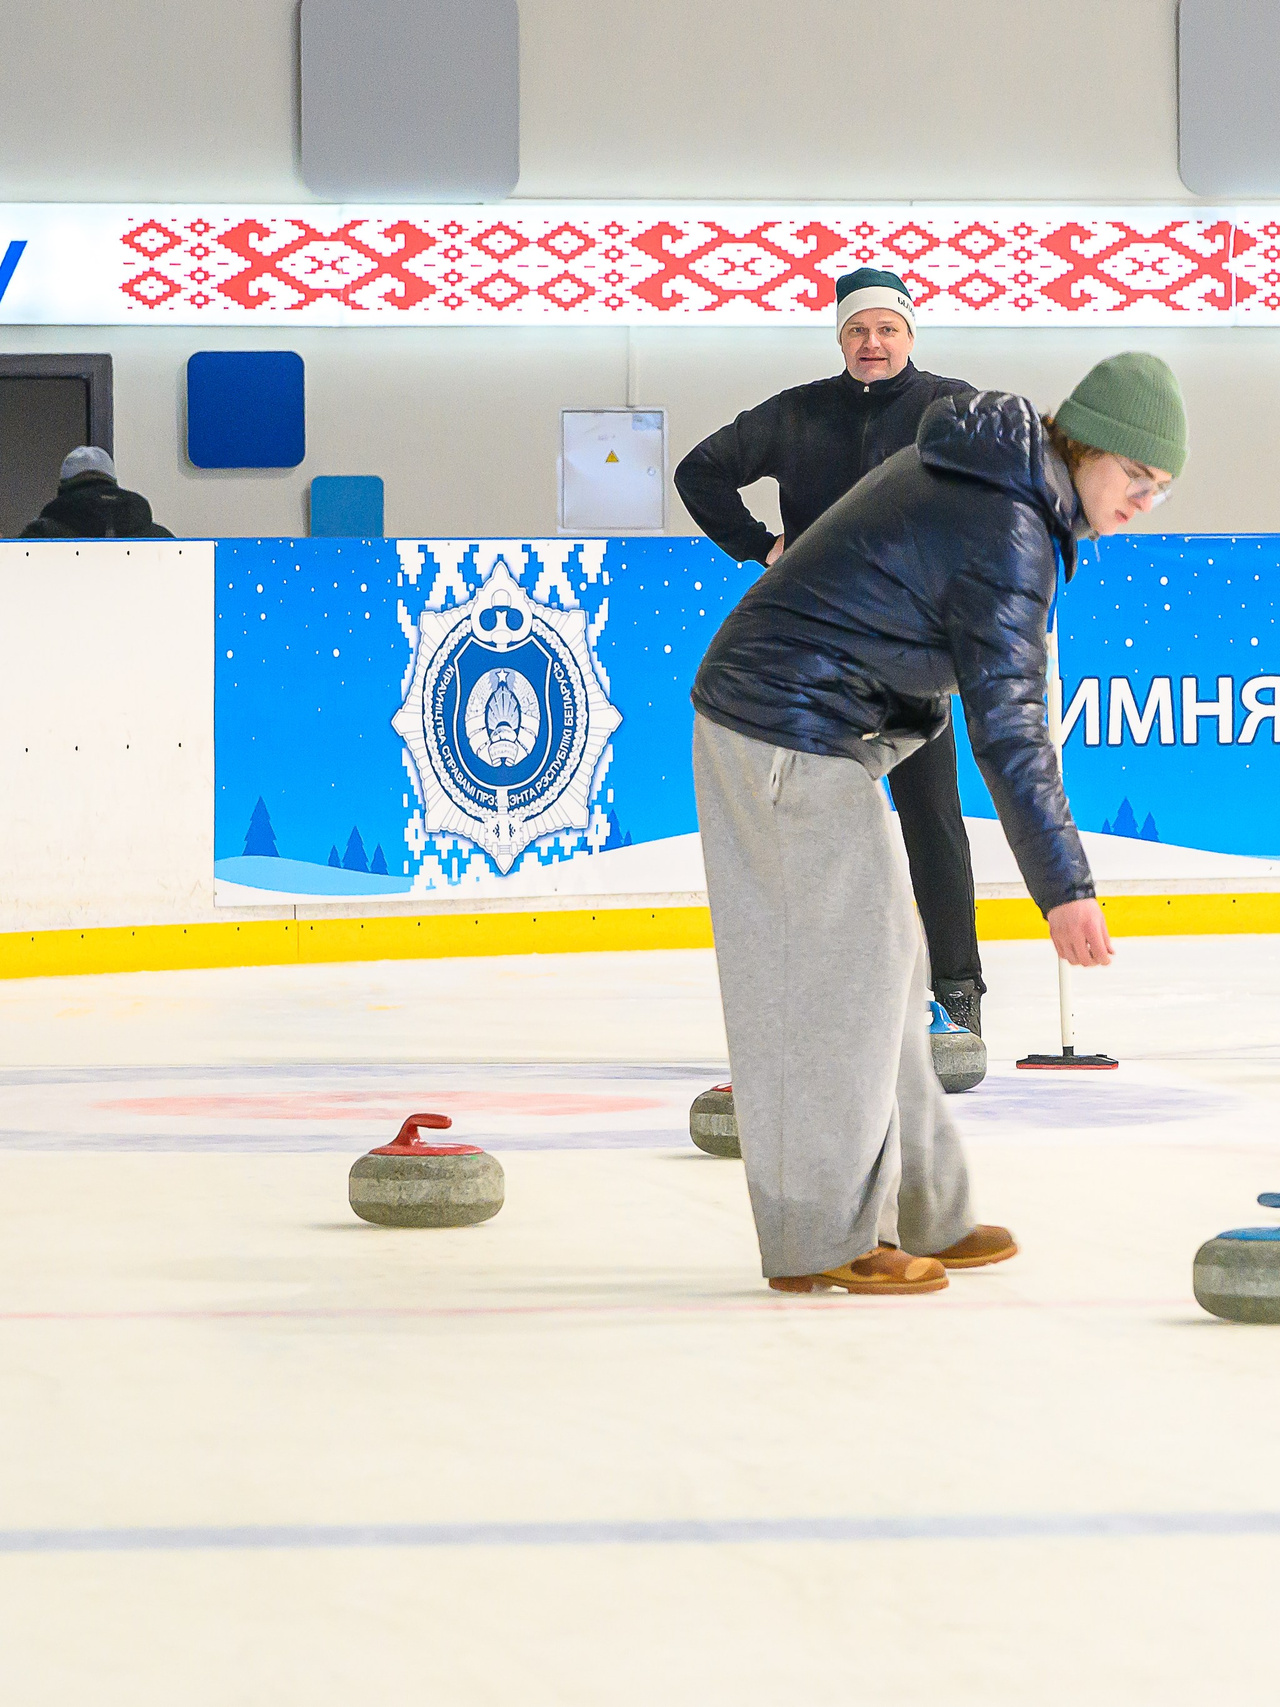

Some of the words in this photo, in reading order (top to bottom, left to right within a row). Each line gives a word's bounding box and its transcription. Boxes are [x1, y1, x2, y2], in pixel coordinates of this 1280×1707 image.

[553, 661, 574, 726] БЕЛАРУСЬ
[442, 745, 477, 797] СПРАВАМІ
[535, 728, 573, 793] РЭСПУБЛІКІ
[476, 787, 538, 806] ПРЭЭНТА
